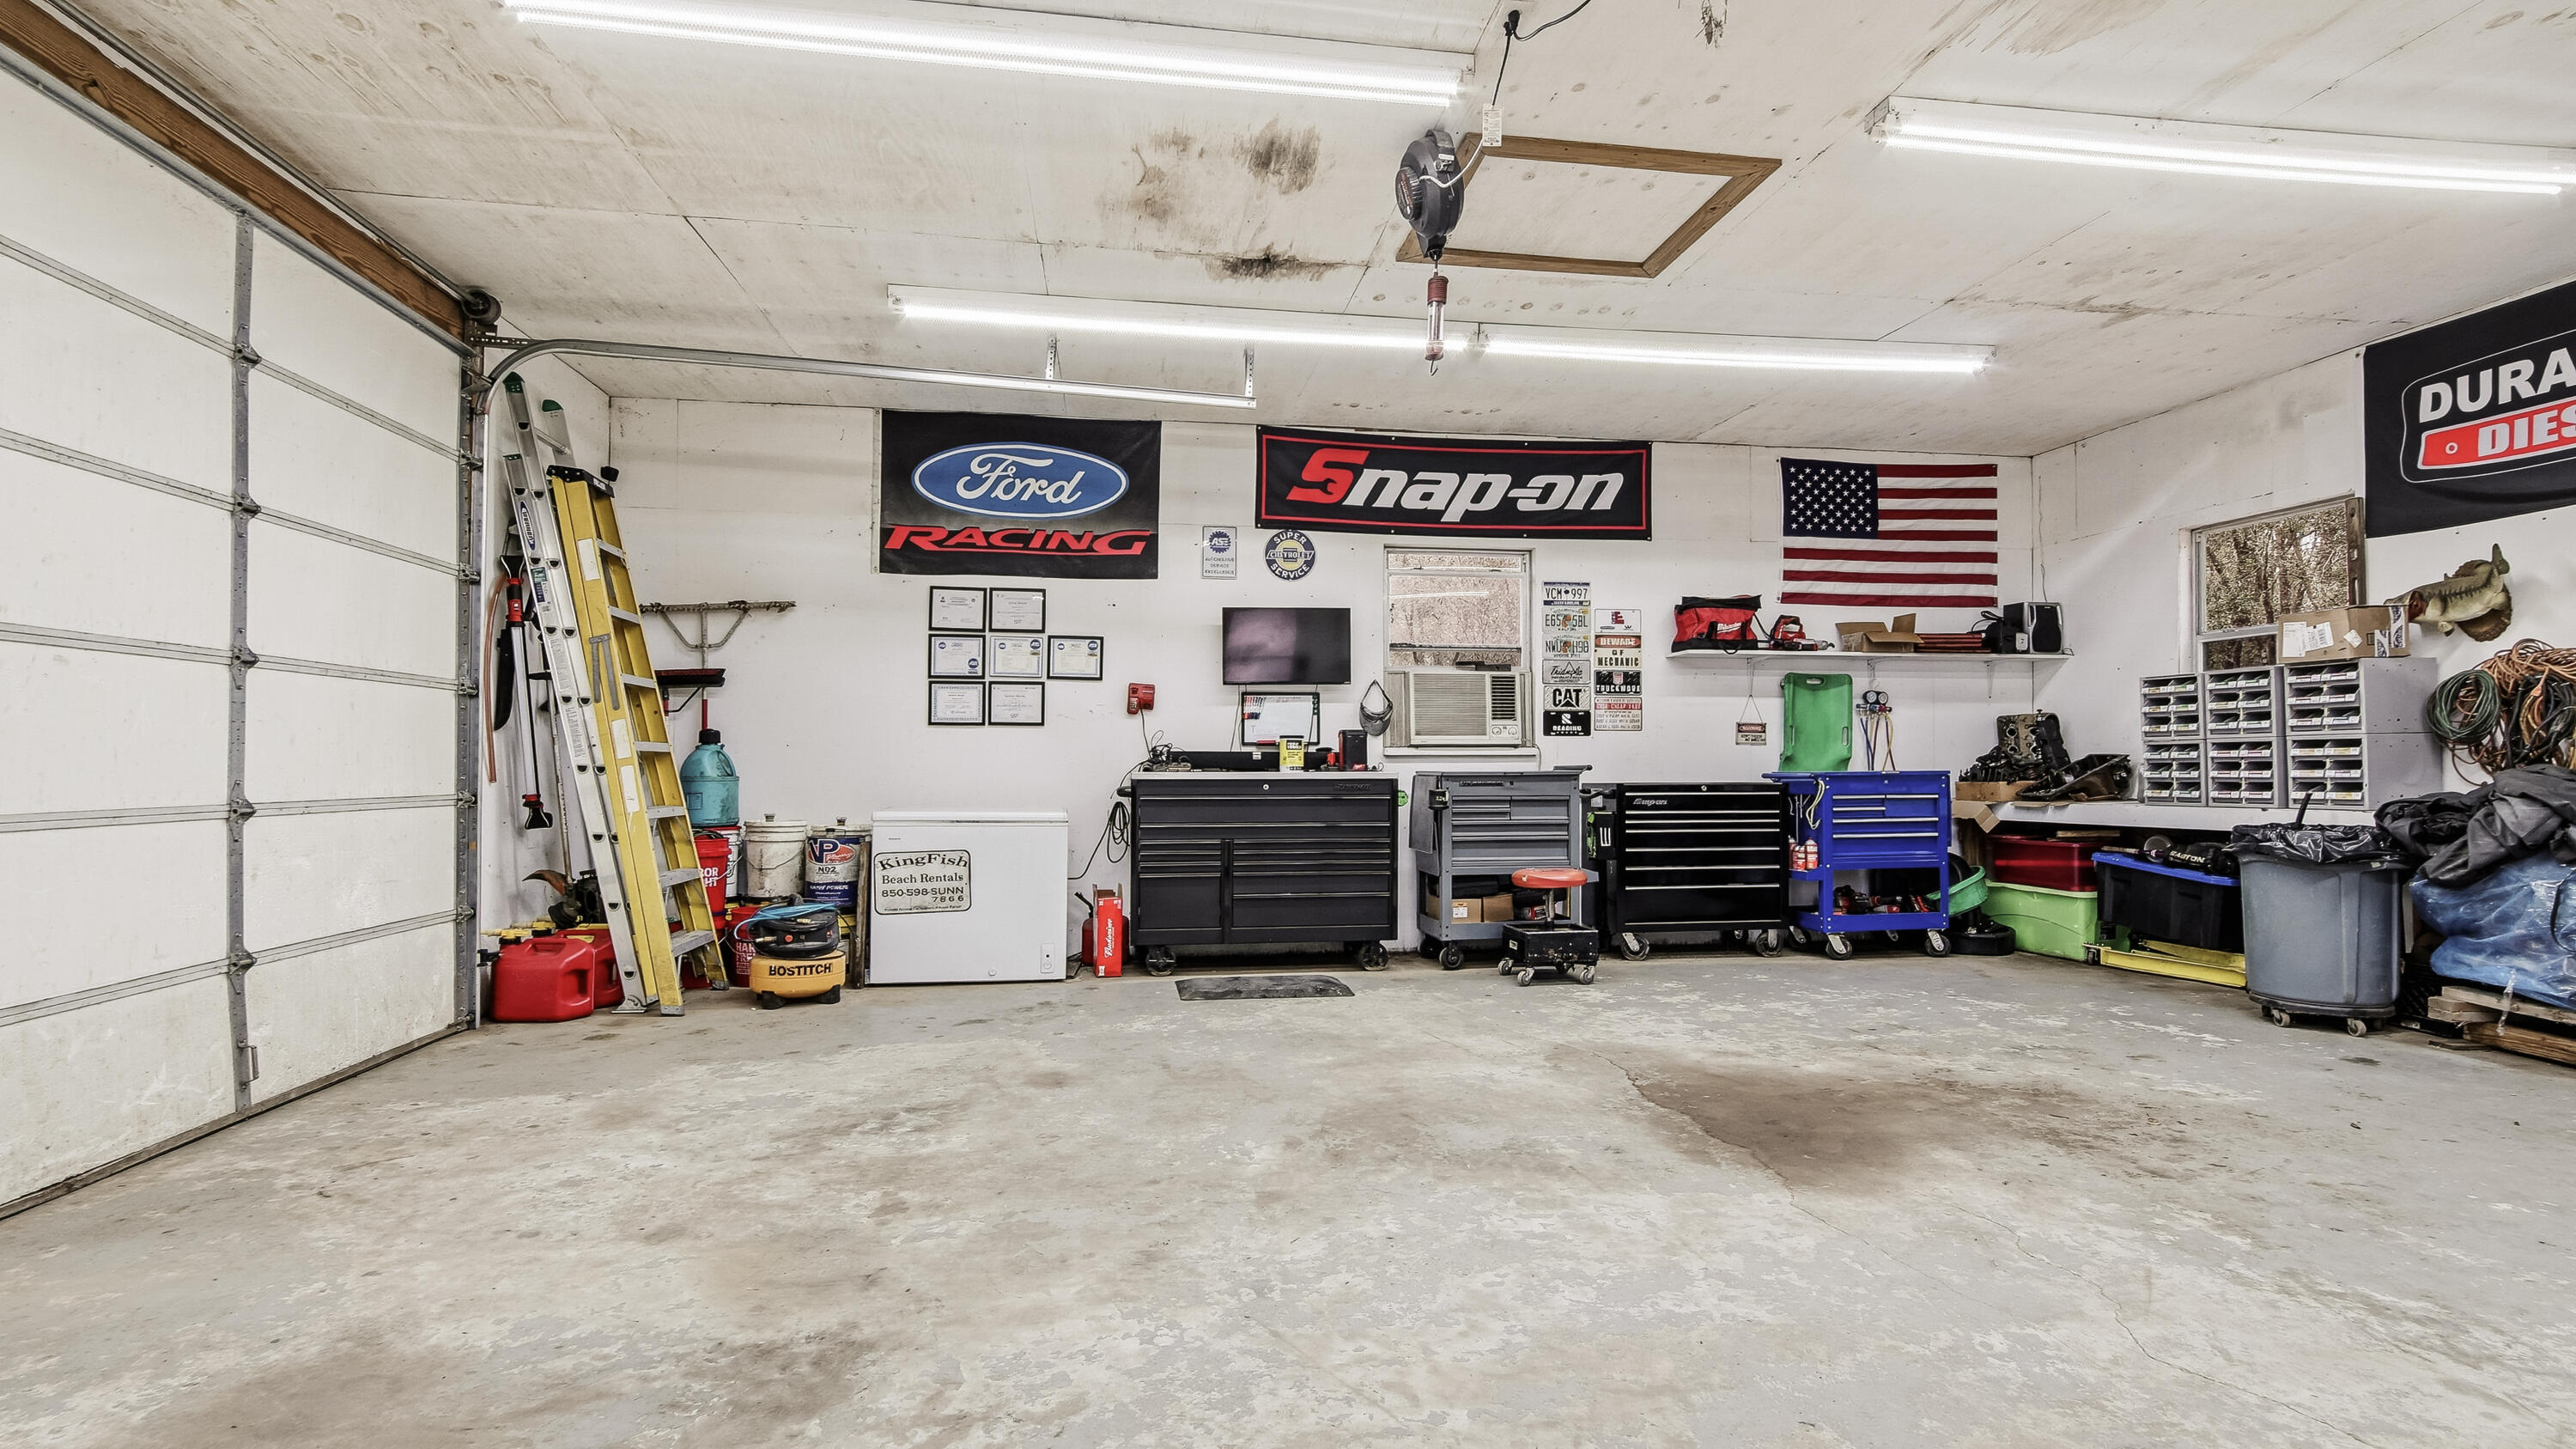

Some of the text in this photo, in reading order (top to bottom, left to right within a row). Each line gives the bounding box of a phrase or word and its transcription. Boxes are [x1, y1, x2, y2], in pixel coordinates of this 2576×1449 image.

[956, 453, 1085, 505] Ford
[1285, 447, 1624, 522] Snap-on
[884, 525, 1151, 556] RACING
[1273, 531, 1307, 545] SUPER
[1270, 563, 1310, 579] SERVICE
[1571, 588, 1588, 600] 997
[1597, 657, 1639, 667] MECHANIC
[1552, 687, 1582, 708] CAT
[878, 853, 969, 871] KingFish
[883, 873, 963, 885] Beach Rentals
[881, 886, 964, 898] 850-598-SUNN
[769, 963, 832, 977] BOSTITCH
